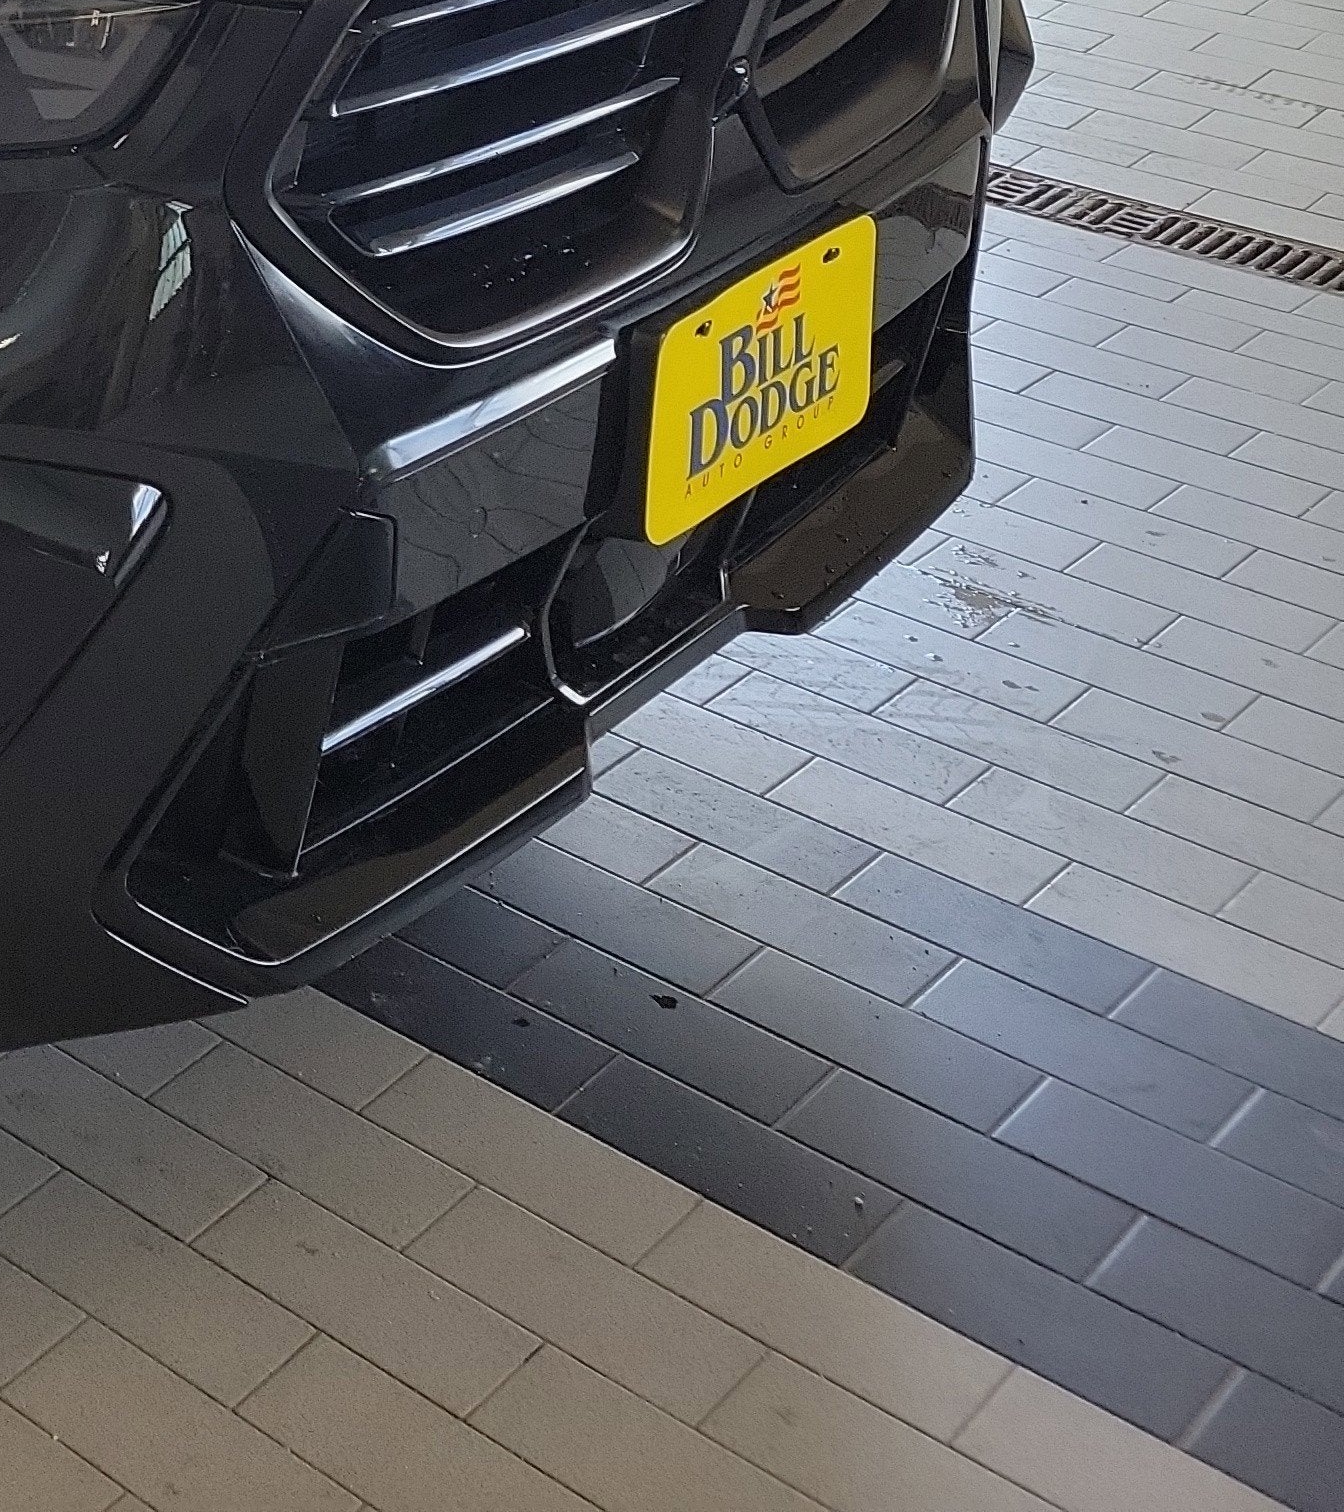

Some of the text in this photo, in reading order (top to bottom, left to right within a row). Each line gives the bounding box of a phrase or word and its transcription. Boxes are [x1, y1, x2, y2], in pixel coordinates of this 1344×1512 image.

[719, 313, 816, 404] BILL
[685, 395, 836, 500] AUTO GROUP
[686, 344, 839, 482] DODGE
